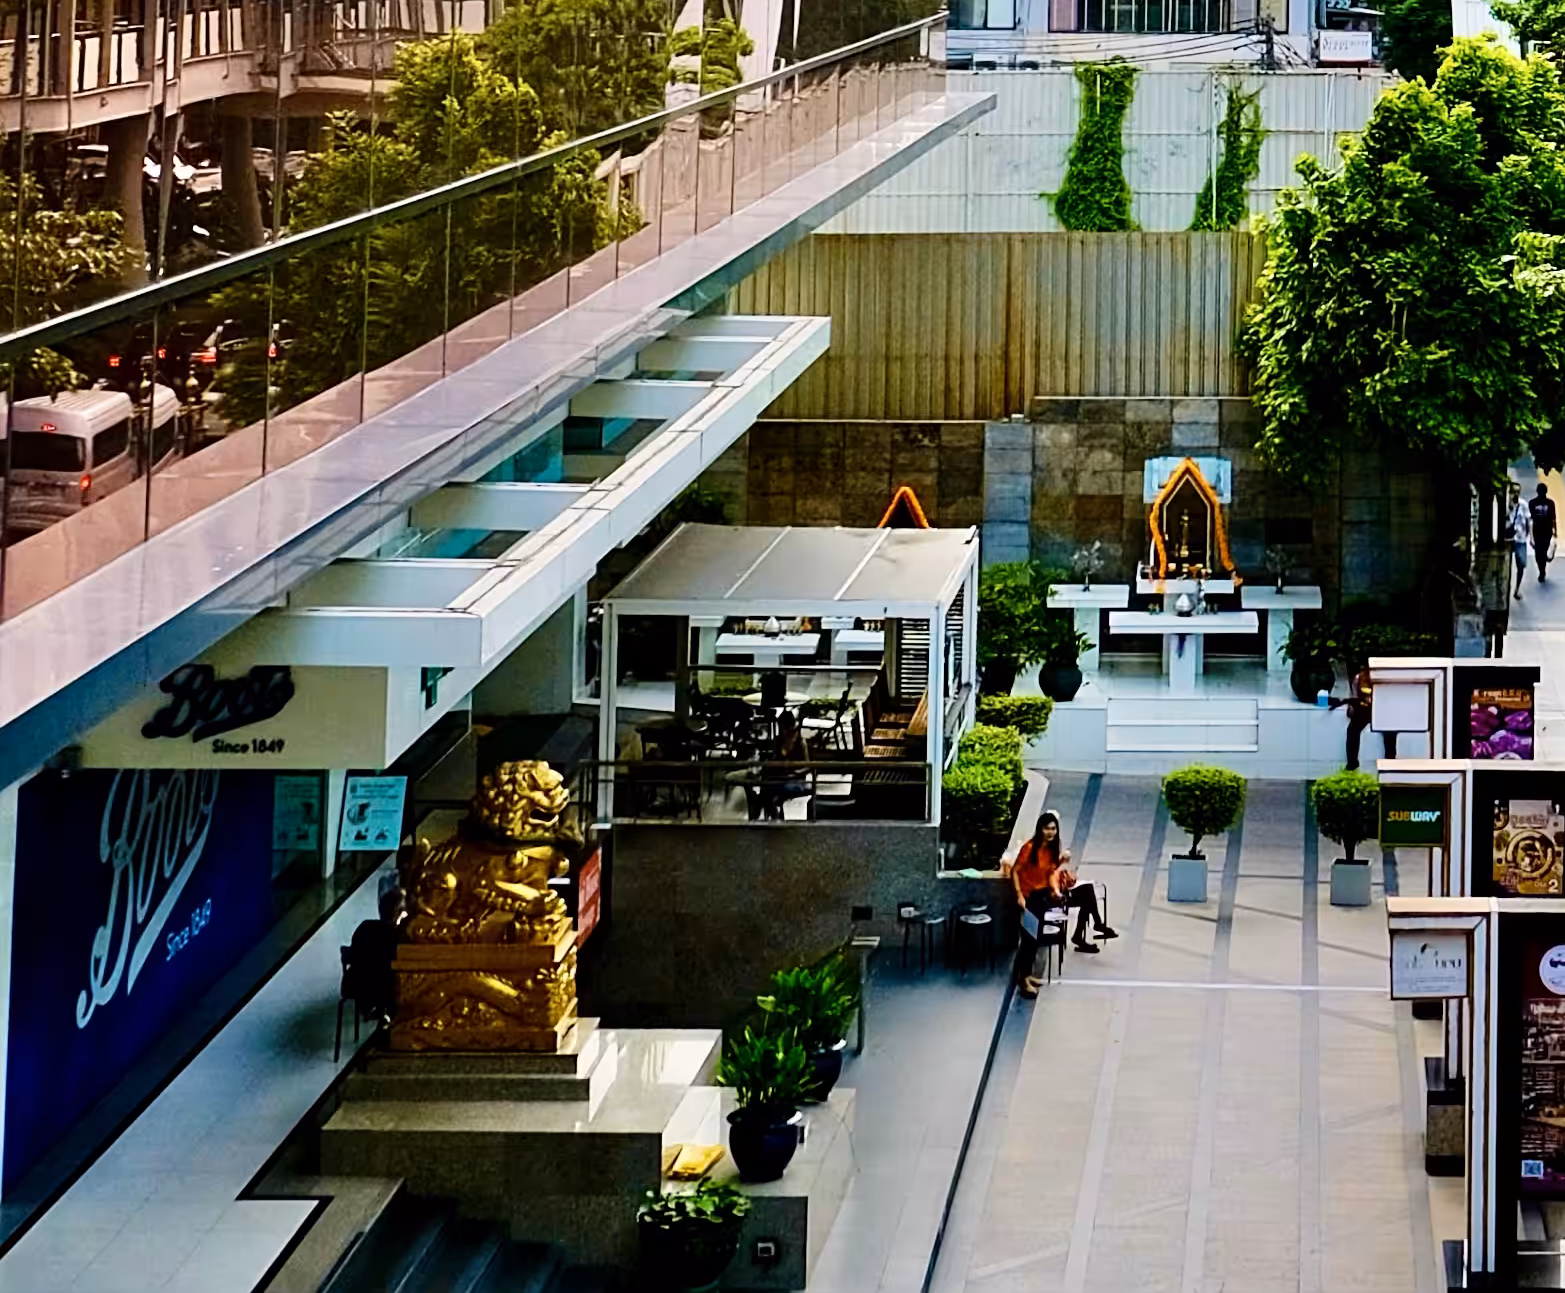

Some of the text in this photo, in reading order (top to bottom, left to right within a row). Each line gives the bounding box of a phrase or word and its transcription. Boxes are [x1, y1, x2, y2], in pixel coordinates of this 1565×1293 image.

[140, 662, 296, 744] Boots
[211, 738, 286, 754] Since 1849
[1386, 810, 1442, 823] SUBWAY
